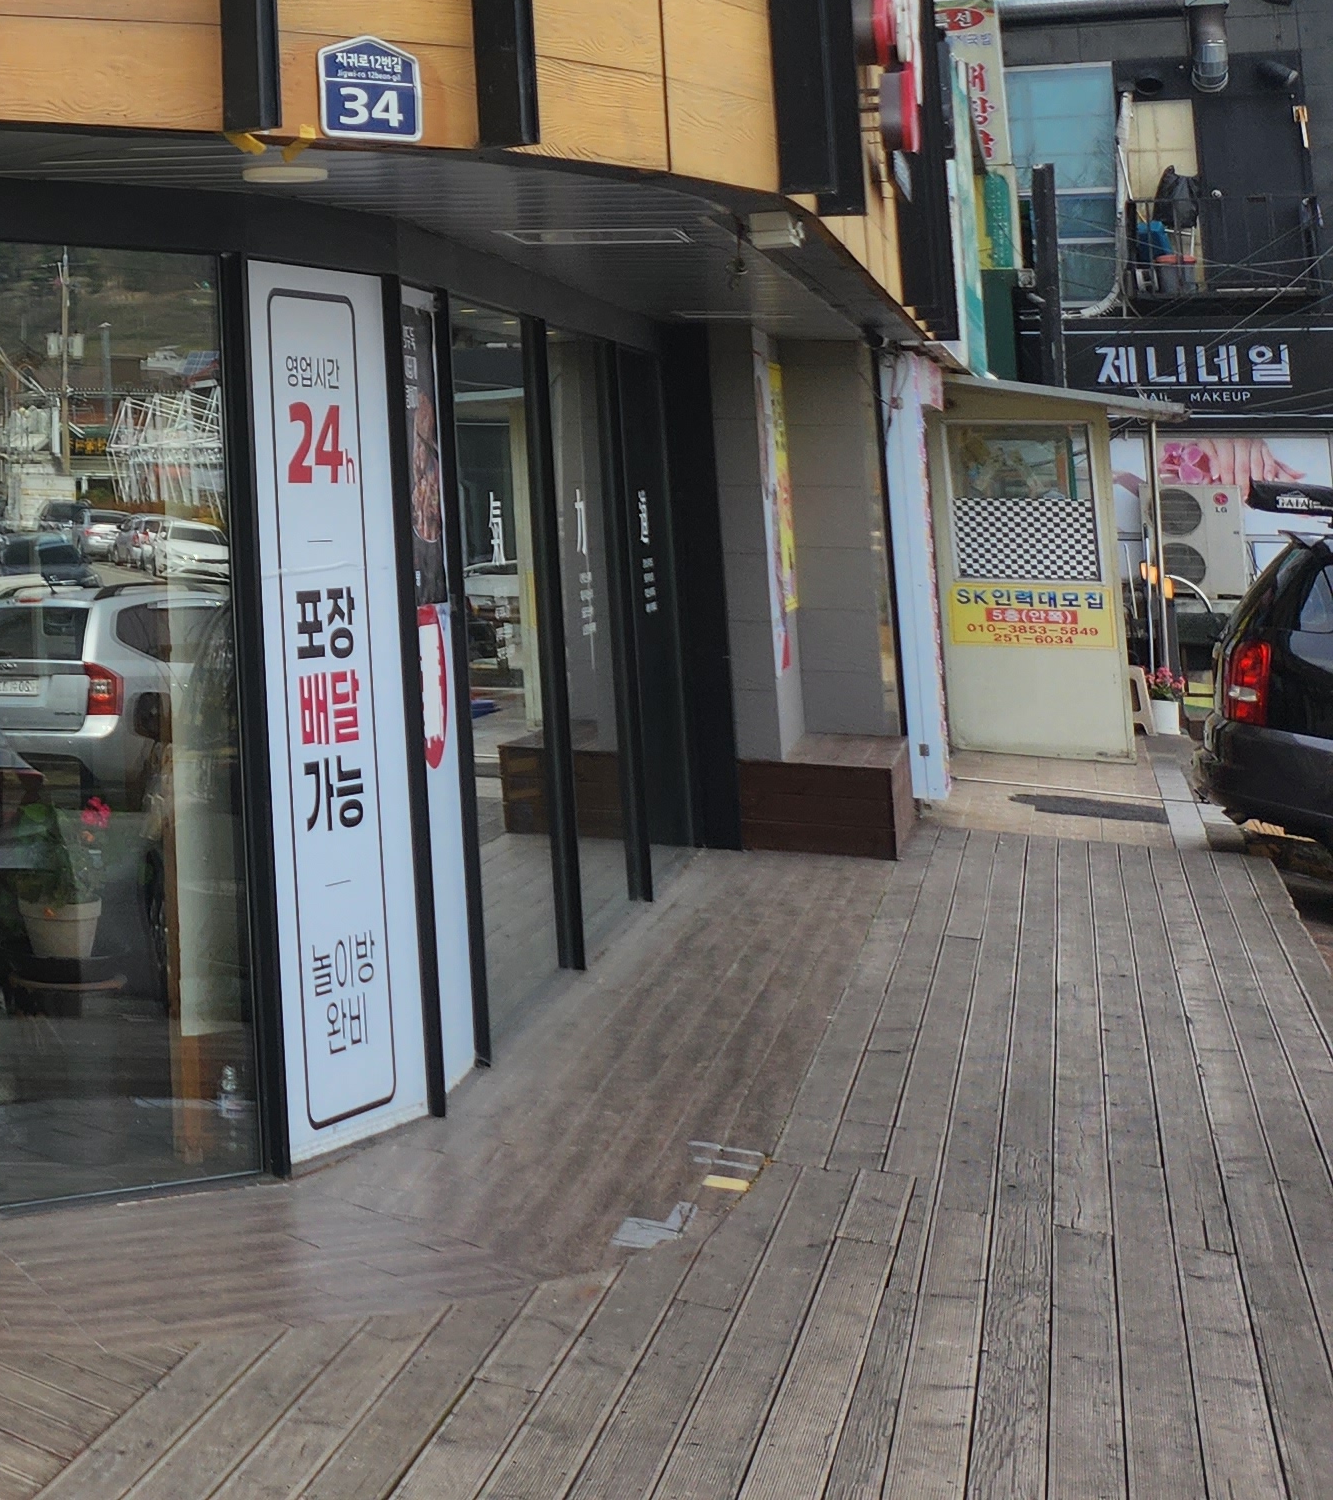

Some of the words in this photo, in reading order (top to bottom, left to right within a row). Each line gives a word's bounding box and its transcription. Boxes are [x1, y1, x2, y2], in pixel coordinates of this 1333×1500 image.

[335, 52, 402, 73] 지귀로12번길
[339, 86, 404, 127] 34
[285, 355, 341, 390] 영업시간
[1094, 344, 1292, 384] 제니네일
[1190, 391, 1252, 402] MAKEUP
[1214, 506, 1229, 514] LG
[295, 585, 356, 660] 포장
[966, 623, 1099, 636] 010-3853-5849
[991, 609, 1073, 623] 5층(안쪽)
[993, 633, 1074, 644] 251-6034
[297, 668, 361, 746] 배달
[303, 754, 365, 833] 가능
[311, 929, 377, 998] 놀이방
[325, 991, 369, 1056] 완비
